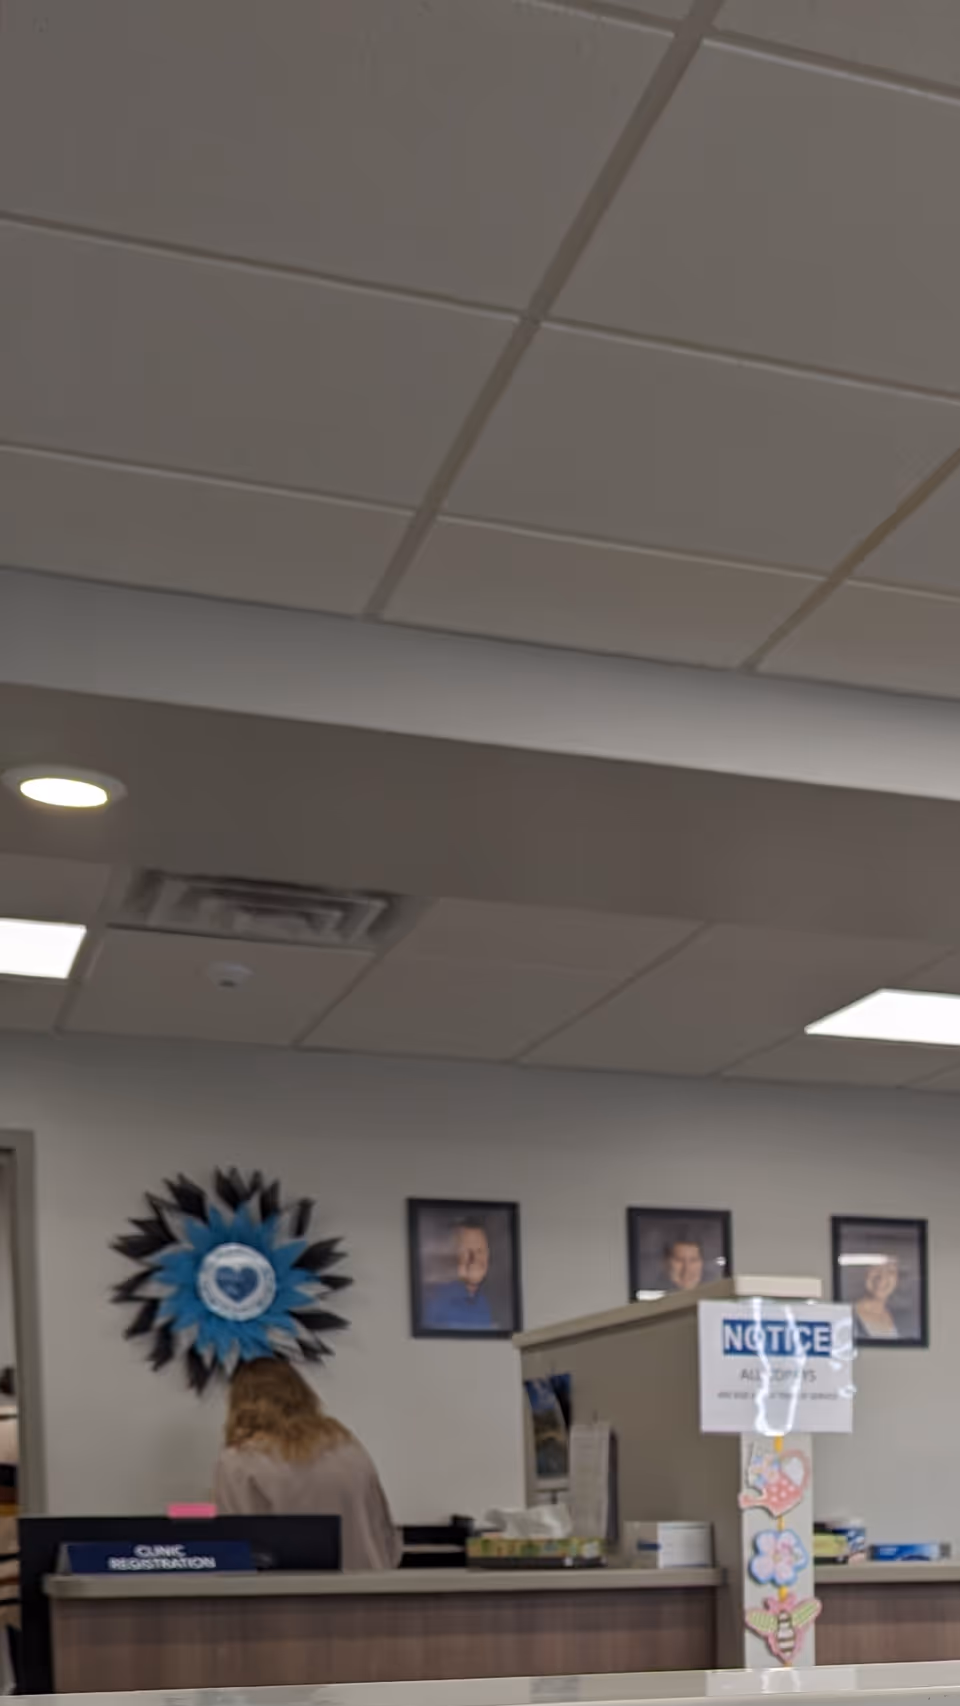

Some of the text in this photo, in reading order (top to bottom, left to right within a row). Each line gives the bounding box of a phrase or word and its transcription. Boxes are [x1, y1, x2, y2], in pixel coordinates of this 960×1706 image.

[724, 1325, 831, 1352] NOTICE
[134, 1544, 187, 1557] CLINIC
[108, 1557, 216, 1570] REGISTRATION
